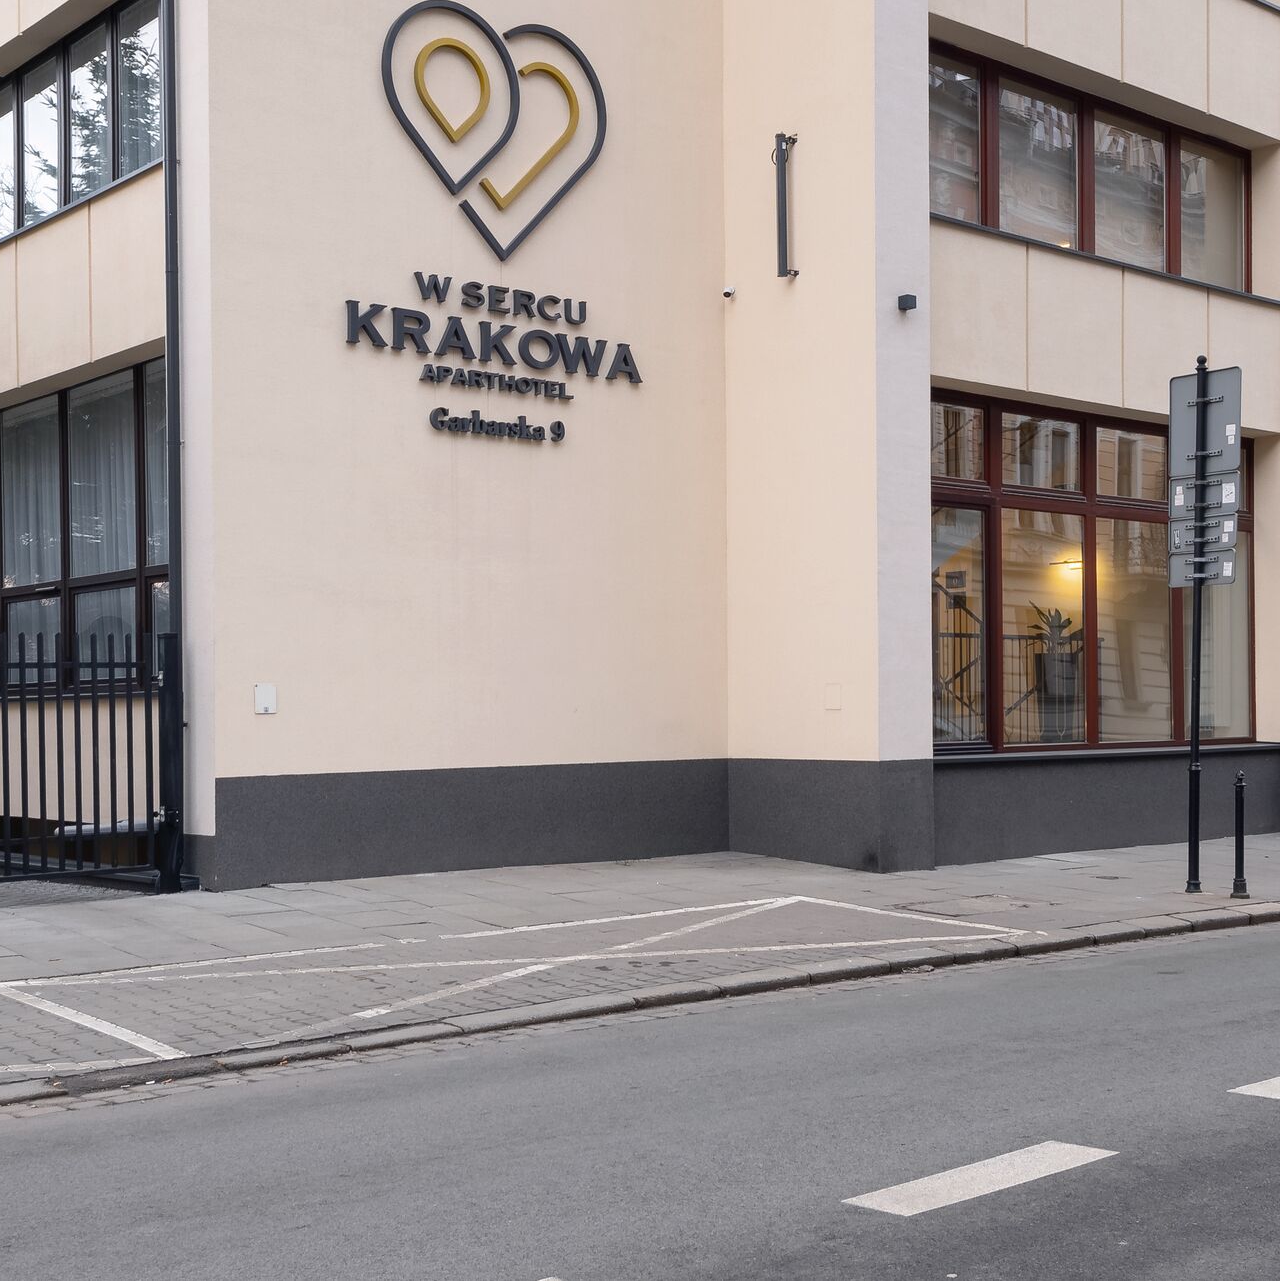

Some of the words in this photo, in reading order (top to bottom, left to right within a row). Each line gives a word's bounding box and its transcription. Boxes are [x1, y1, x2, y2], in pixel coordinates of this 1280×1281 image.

[413, 271, 452, 303] W
[460, 281, 587, 326] SERCU
[345, 299, 643, 384] KRAKOWA
[419, 363, 575, 401] APARTHOTEL
[428, 407, 547, 442] Garbarska
[550, 420, 566, 442] 9
